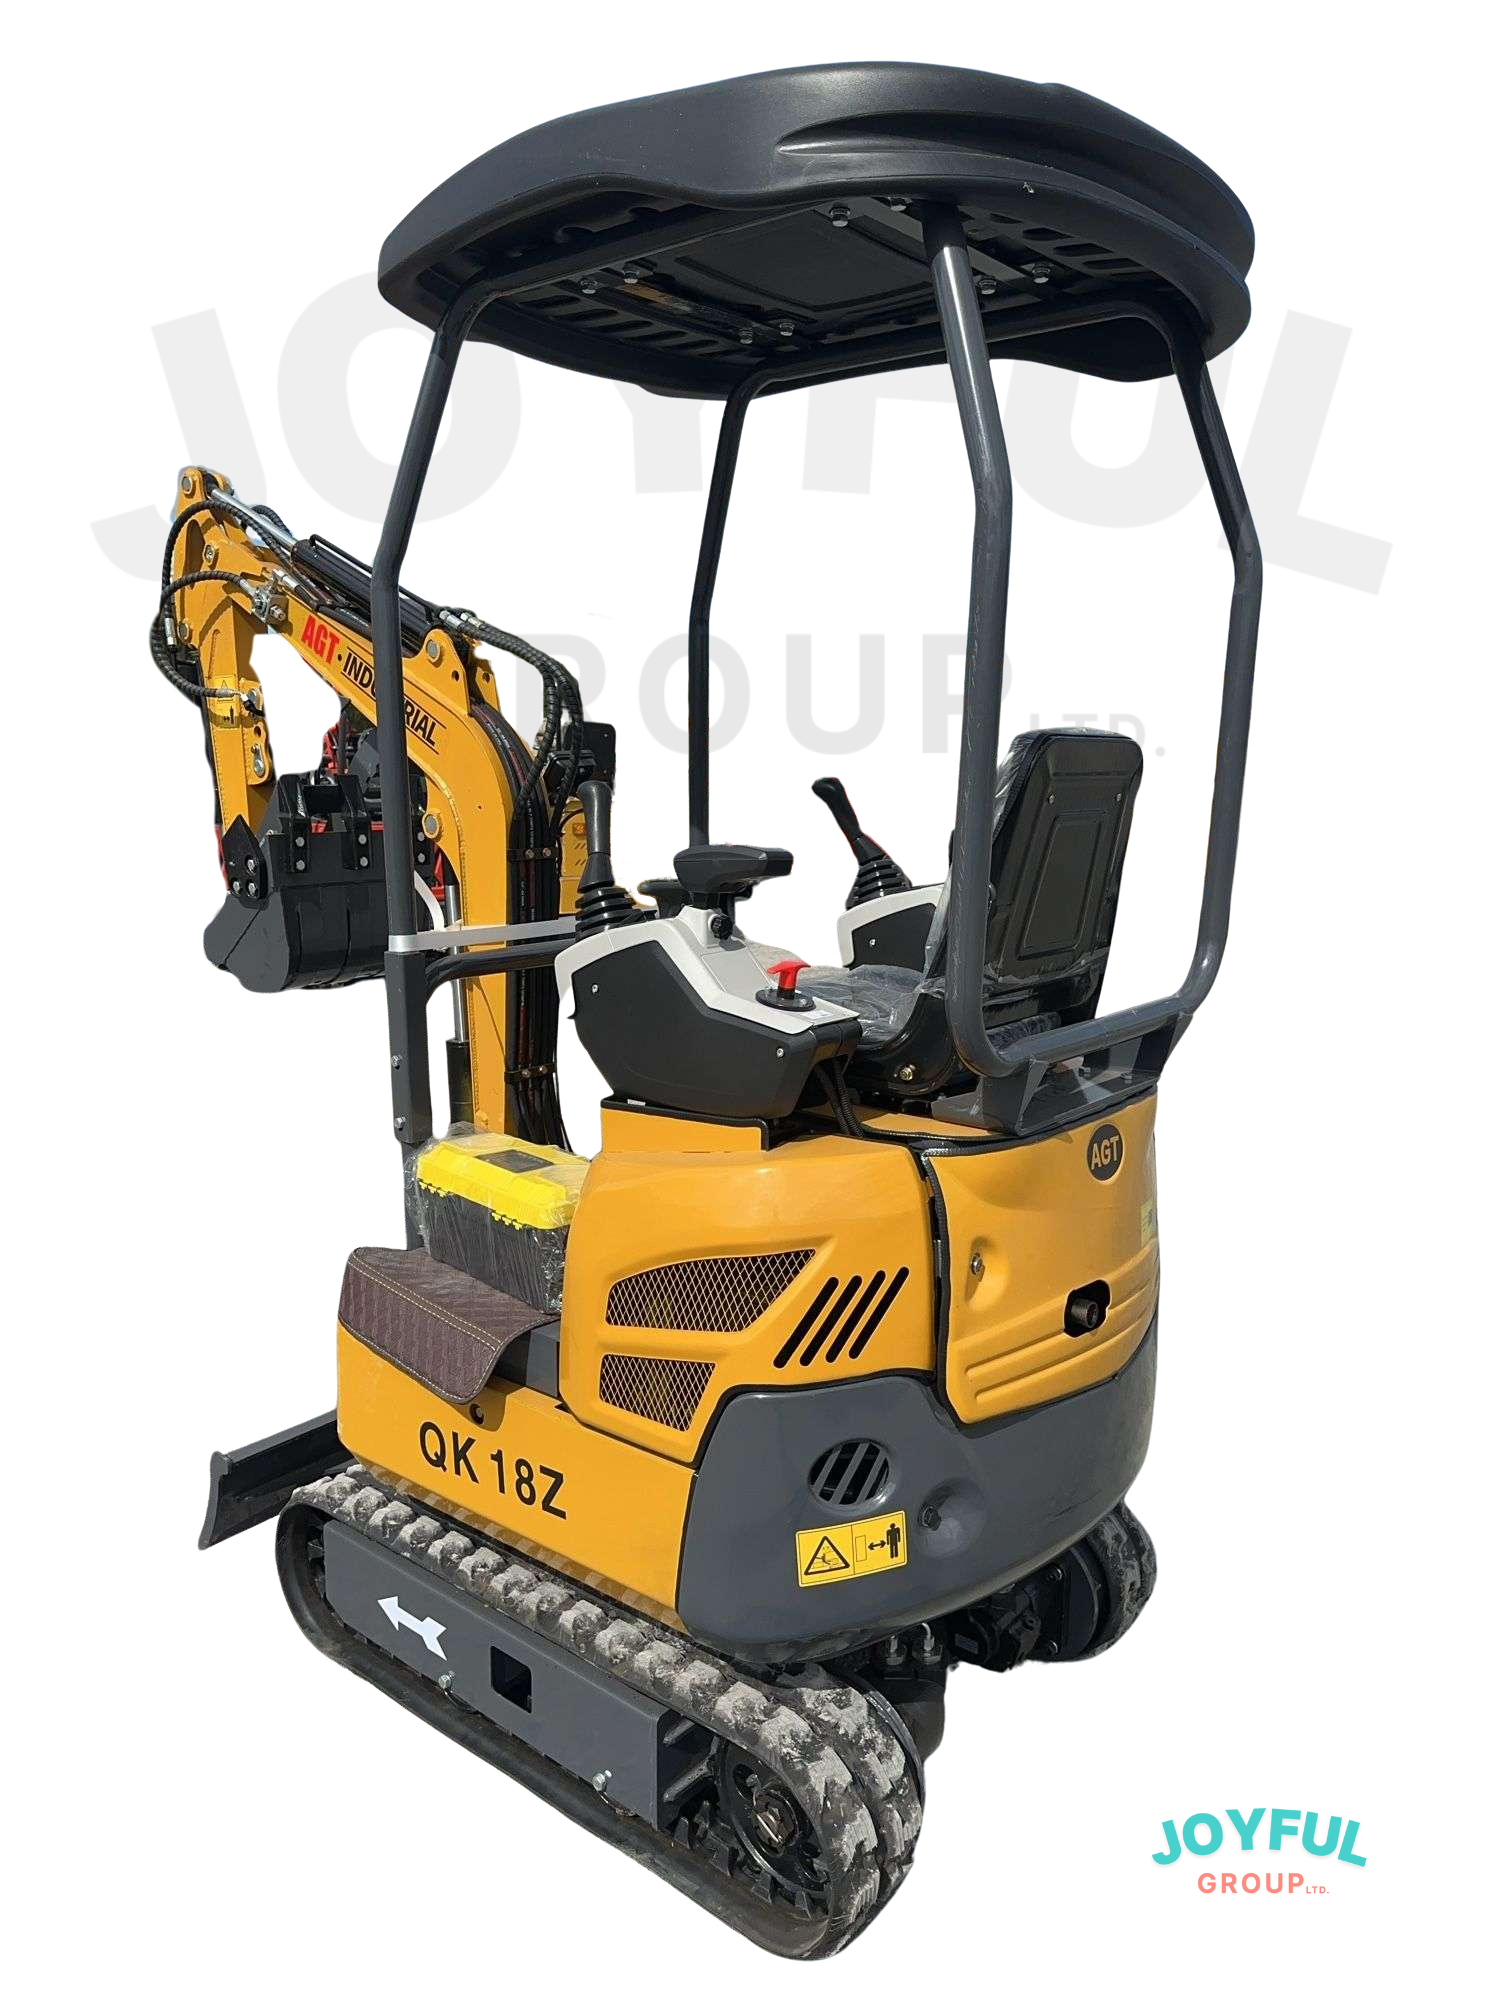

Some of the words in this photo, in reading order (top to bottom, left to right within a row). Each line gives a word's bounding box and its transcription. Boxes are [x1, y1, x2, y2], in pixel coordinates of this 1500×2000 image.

[302, 614, 340, 664] AGT
[343, 652, 436, 748] INDRIAL
[1091, 1134, 1120, 1170] AGT
[420, 1421, 479, 1484] QK
[490, 1449, 567, 1520] 18Z
